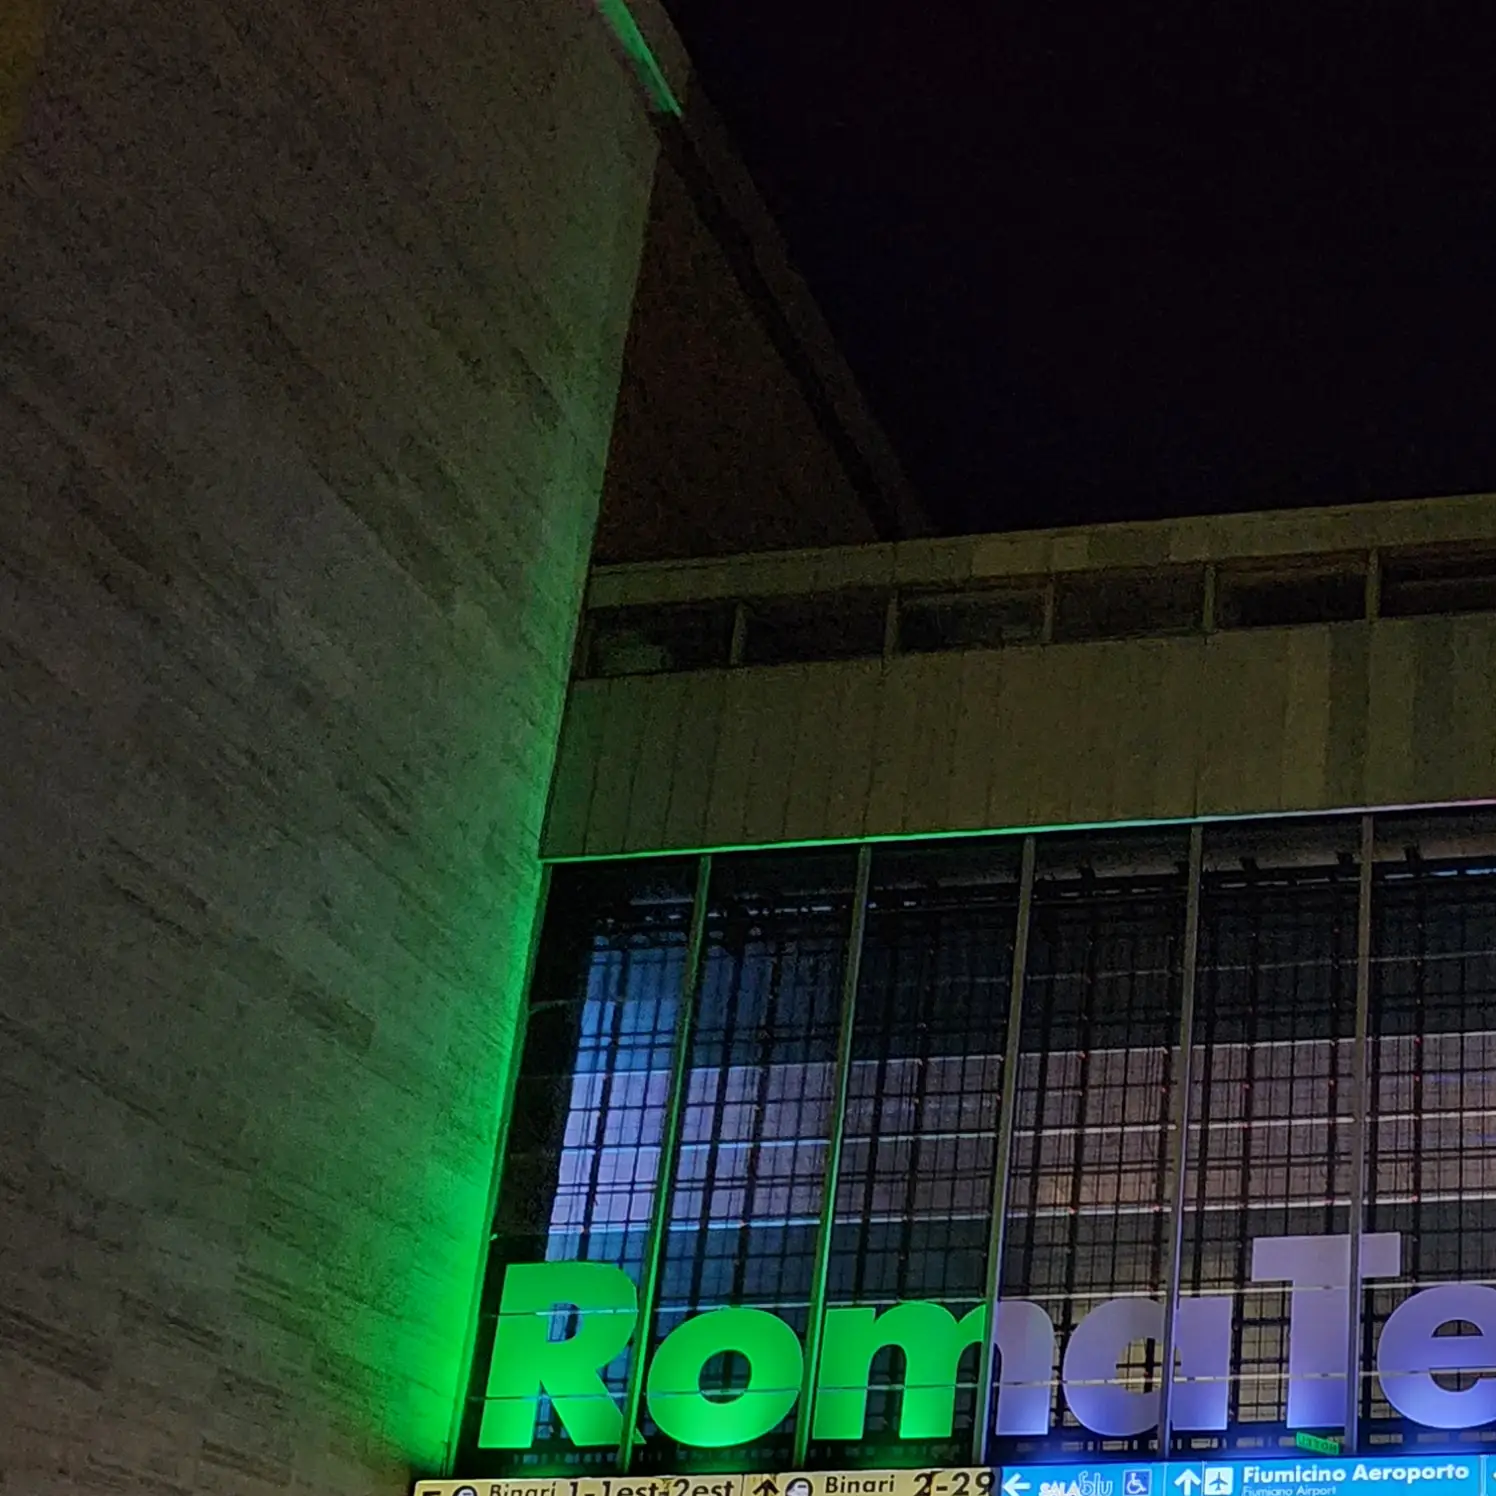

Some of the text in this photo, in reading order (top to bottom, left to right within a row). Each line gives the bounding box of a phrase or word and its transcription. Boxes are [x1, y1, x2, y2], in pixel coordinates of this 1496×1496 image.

[1243, 1462, 1469, 1484] Fiumicino Aeroporto
[824, 1475, 896, 1496] Binari
